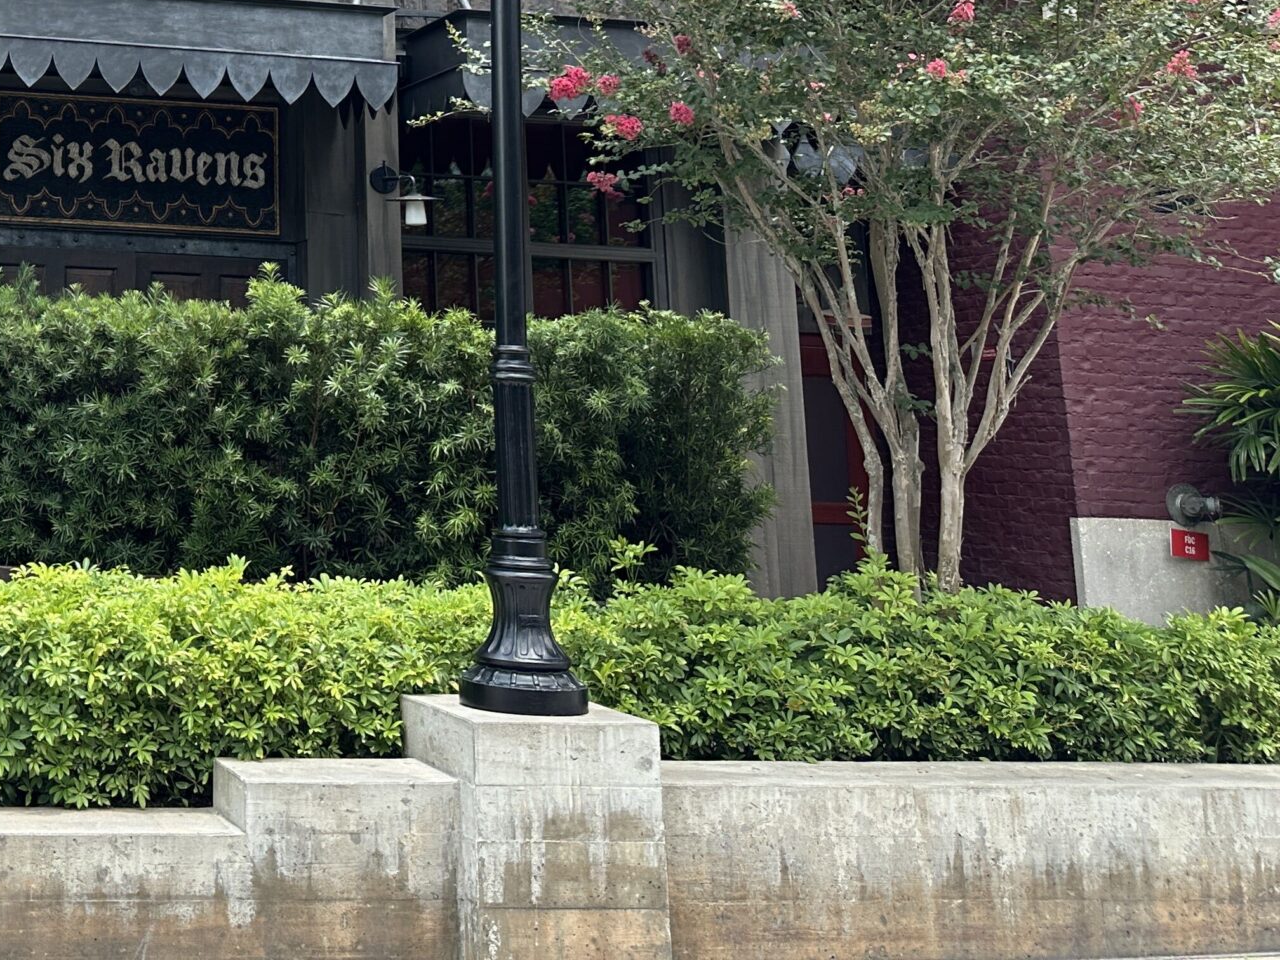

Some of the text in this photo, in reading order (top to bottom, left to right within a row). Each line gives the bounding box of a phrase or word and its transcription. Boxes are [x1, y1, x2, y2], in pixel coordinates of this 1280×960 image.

[3, 133, 267, 189] Six Ravens
[1184, 536, 1196, 545] FDC
